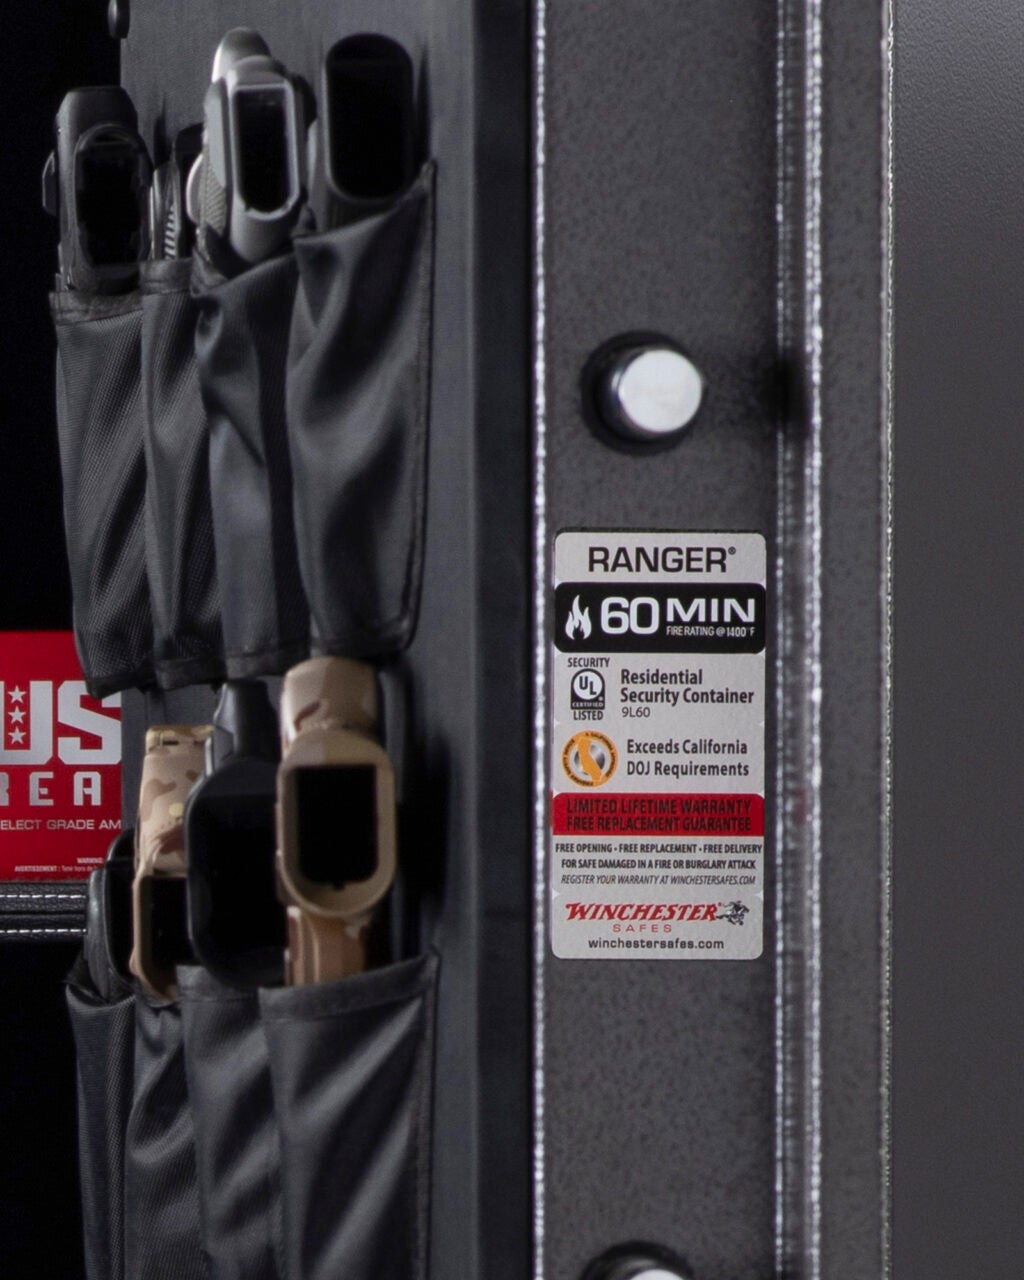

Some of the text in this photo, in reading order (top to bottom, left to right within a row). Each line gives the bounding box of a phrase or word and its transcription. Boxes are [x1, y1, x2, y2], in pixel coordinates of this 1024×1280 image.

[600, 596, 755, 634] 60 MIN
[666, 626, 683, 636] FIRE
[683, 626, 714, 636] RATING
[567, 657, 610, 668] SECURITY
[621, 669, 703, 685] Residential
[620, 687, 754, 706] Security Container
[573, 710, 604, 721] LISTED
[621, 706, 651, 718] 9L60
[627, 739, 747, 755] Exceeds California
[627, 761, 749, 779] DOJ Requirements
[567, 798, 752, 814] LIMITED LIFETIME WARRANTY
[46, 819, 95, 831] GRADE
[567, 816, 752, 831] FREE REPLACEMENT GUARANTEE
[555, 843, 762, 854] FREE OPENING FREE REPLACEMENT FREE DELIVERY
[561, 859, 577, 869] FOR
[578, 859, 597, 869] SAFE
[598, 859, 636, 869] DAMAGED
[637, 859, 646, 869] IN
[655, 860, 672, 869] FIRE
[673, 860, 684, 869] OR
[685, 860, 726, 870] BURGLARY
[728, 860, 756, 870] ATTACK
[561, 874, 756, 885] REGISTER YOUR WARRANTY AT WINCHESTERSAFES.COM
[565, 902, 718, 922] WINCHESTER
[613, 924, 673, 933] SAFES
[588, 937, 725, 949] winchestersafes.com
